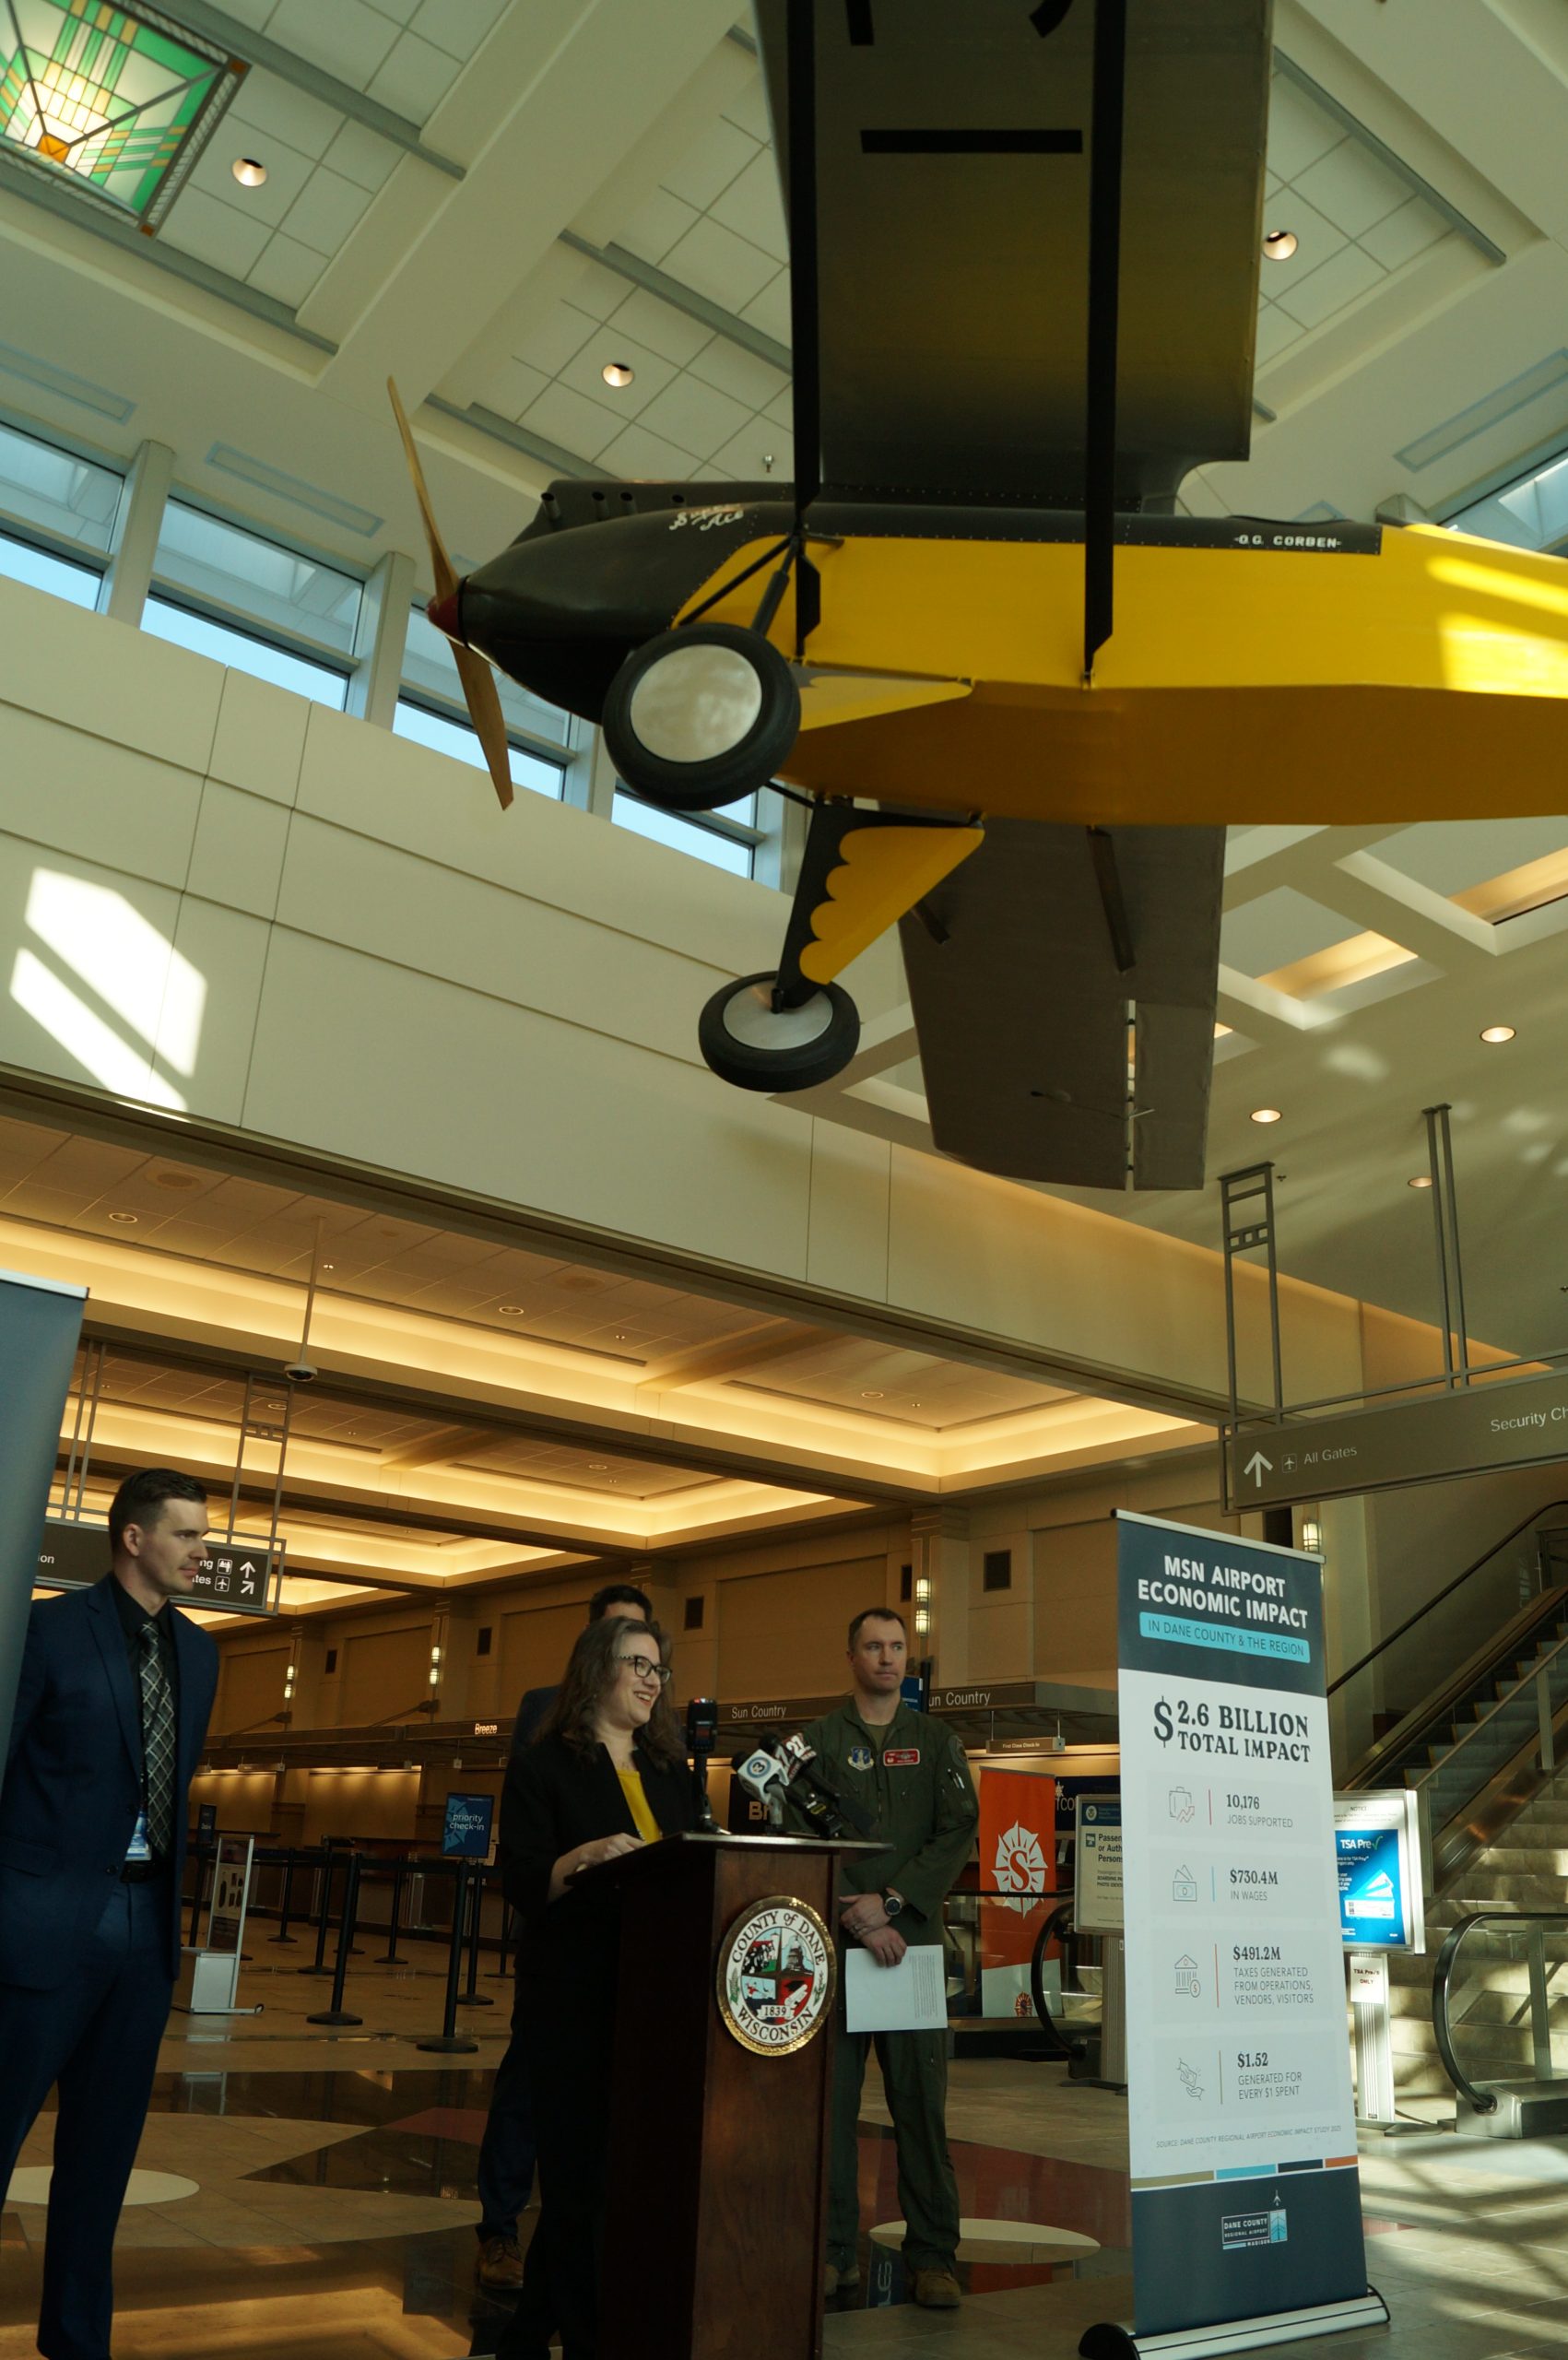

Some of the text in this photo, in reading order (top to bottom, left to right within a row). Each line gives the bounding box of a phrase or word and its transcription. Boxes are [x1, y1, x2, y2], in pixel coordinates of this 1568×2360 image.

[1273, 535, 1337, 548] CORBEN
[1491, 1411, 1546, 1433] Security
[1303, 1446, 1358, 1465] All Gates
[1164, 1555, 1285, 1598] MSN AIRPORT
[1138, 1579, 1308, 1629] ECONOMIC IMPACT
[1148, 1620, 1304, 1656] IN DANE COUNTY & THE REGION
[928, 1695, 941, 1706] un
[946, 1691, 991, 1707] Country
[731, 1705, 786, 1719] Sun Country
[474, 1723, 498, 1735] Breeze
[1220, 1705, 1308, 1739] BILLION
[1177, 1731, 1310, 1763] TOTAL IMPACT
[1226, 1794, 1260, 1811] 10,176
[449, 1821, 485, 1831] check-in
[453, 1814, 484, 1824] priority
[1227, 1814, 1293, 1828] JOBS SUPPORTED
[1340, 1839, 1356, 1849] TSA
[1009, 1850, 1030, 1891] S
[1230, 1869, 1279, 1885] $730.4M
[1231, 1891, 1267, 1901] IN WAGES
[732, 1910, 826, 1965] COUNTY of DANE
[1232, 1945, 1281, 1961] $491.2M
[1234, 1966, 1308, 1977] TAXES GENERATED
[1234, 1980, 1314, 1992] FROM OPERATIONS,
[1234, 1993, 1314, 2006] VENDORS, VISITORS
[764, 2006, 786, 2016] 1839
[737, 2007, 814, 2041] WISCONSIN
[1238, 2052, 1268, 2068] $1.52
[1238, 2071, 1303, 2086] GENERATED FOR
[1239, 2085, 1300, 2100] EVERY $1 SPENT
[1180, 2137, 1194, 2146] DANE
[1195, 2136, 1217, 2144] COUNTY
[1218, 2133, 1245, 2142] REGIONAL
[1246, 2131, 1267, 2140] AIRPORT
[1267, 2129, 1293, 2138] ECONOMIC
[1294, 2127, 1313, 2135] IMPACT
[1314, 2126, 1330, 2134] STUDY
[1223, 2218, 1267, 2230] DANE COUNTY
